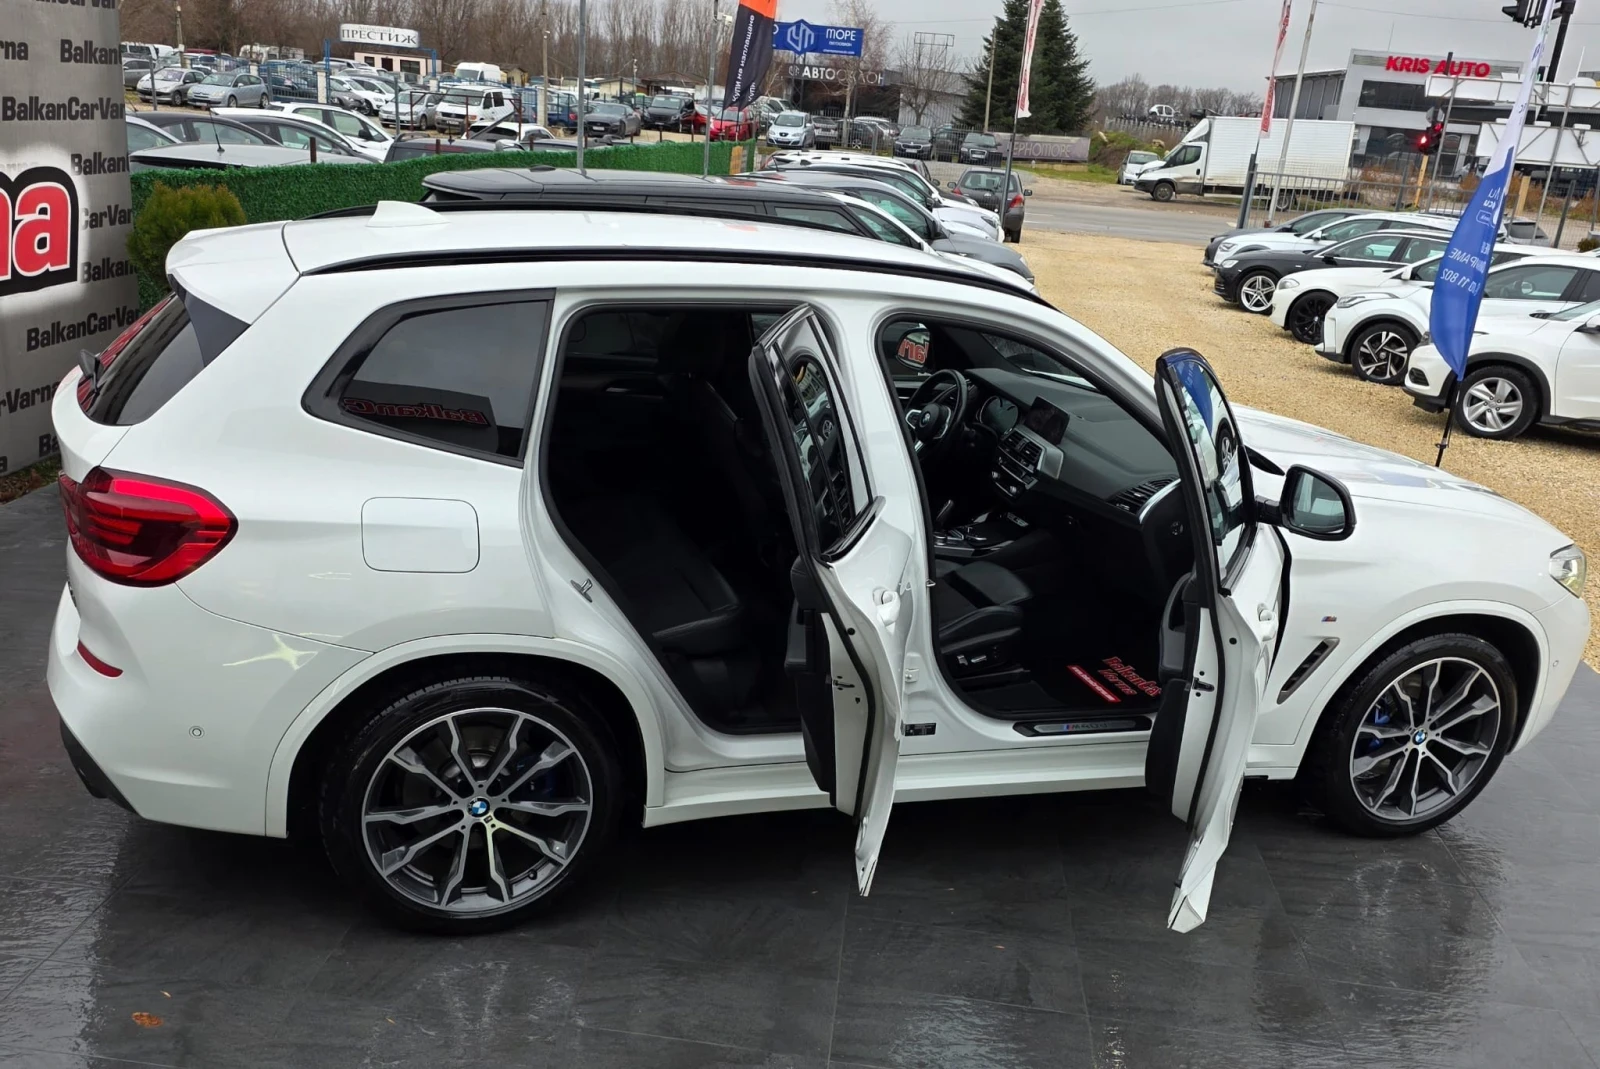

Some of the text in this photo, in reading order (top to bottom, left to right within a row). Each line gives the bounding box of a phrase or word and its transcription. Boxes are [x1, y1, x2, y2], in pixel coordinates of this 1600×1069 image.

[341, 29, 417, 44] ПРЕСТИЖ
[1386, 55, 1491, 78] KRIS AUTO
